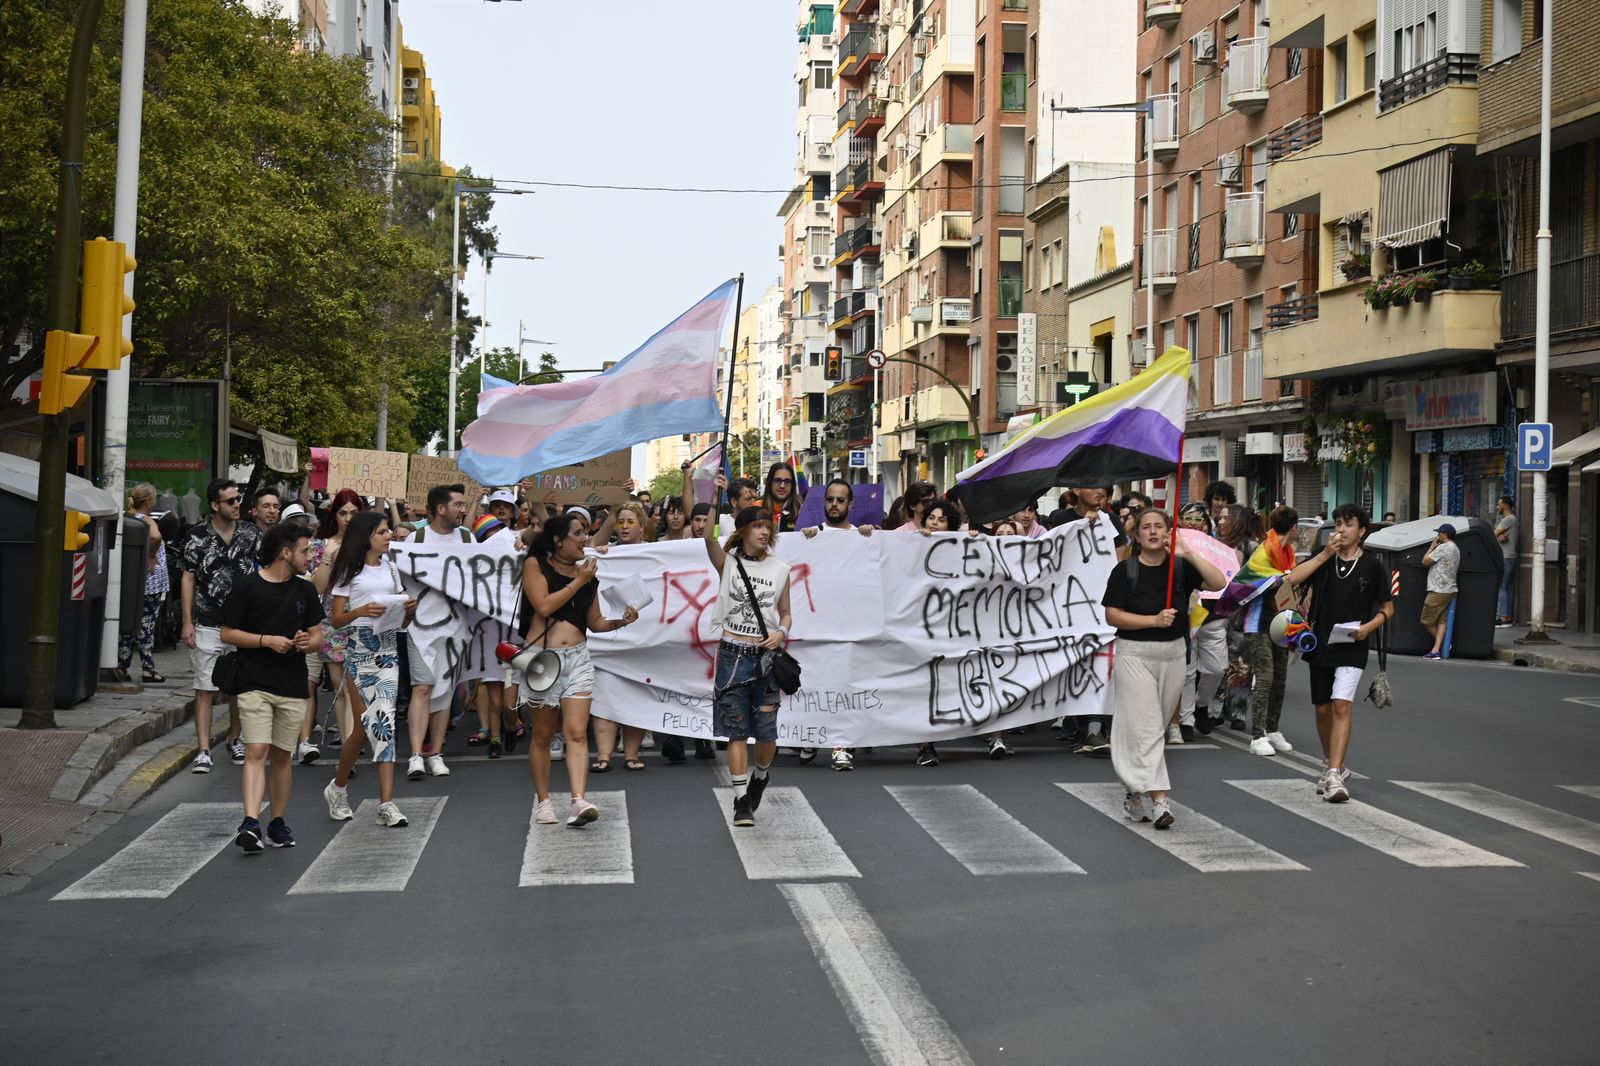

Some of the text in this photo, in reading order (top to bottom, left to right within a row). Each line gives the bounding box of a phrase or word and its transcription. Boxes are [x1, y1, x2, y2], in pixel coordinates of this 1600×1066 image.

[1020, 316, 1035, 402] HELADERIA
[175, 404, 188, 412] en
[147, 415, 170, 426] FAIRY
[136, 430, 148, 439] de
[148, 430, 185, 440] Verano?
[1524, 429, 1544, 465] P
[331, 449, 377, 466] PREFIERO
[383, 452, 402, 467] SER
[413, 457, 458, 472] MIS PRONO
[330, 463, 370, 478] MARICA
[385, 467, 404, 483] SER
[411, 471, 424, 481] NO
[535, 474, 578, 491] TRANS
[342, 477, 393, 496] FASCISTA
[923, 521, 1112, 586] CENTRO DE
[408, 552, 525, 616] FORM
[923, 574, 1101, 641] MEMORIA
[778, 723, 829, 744] CIALES
